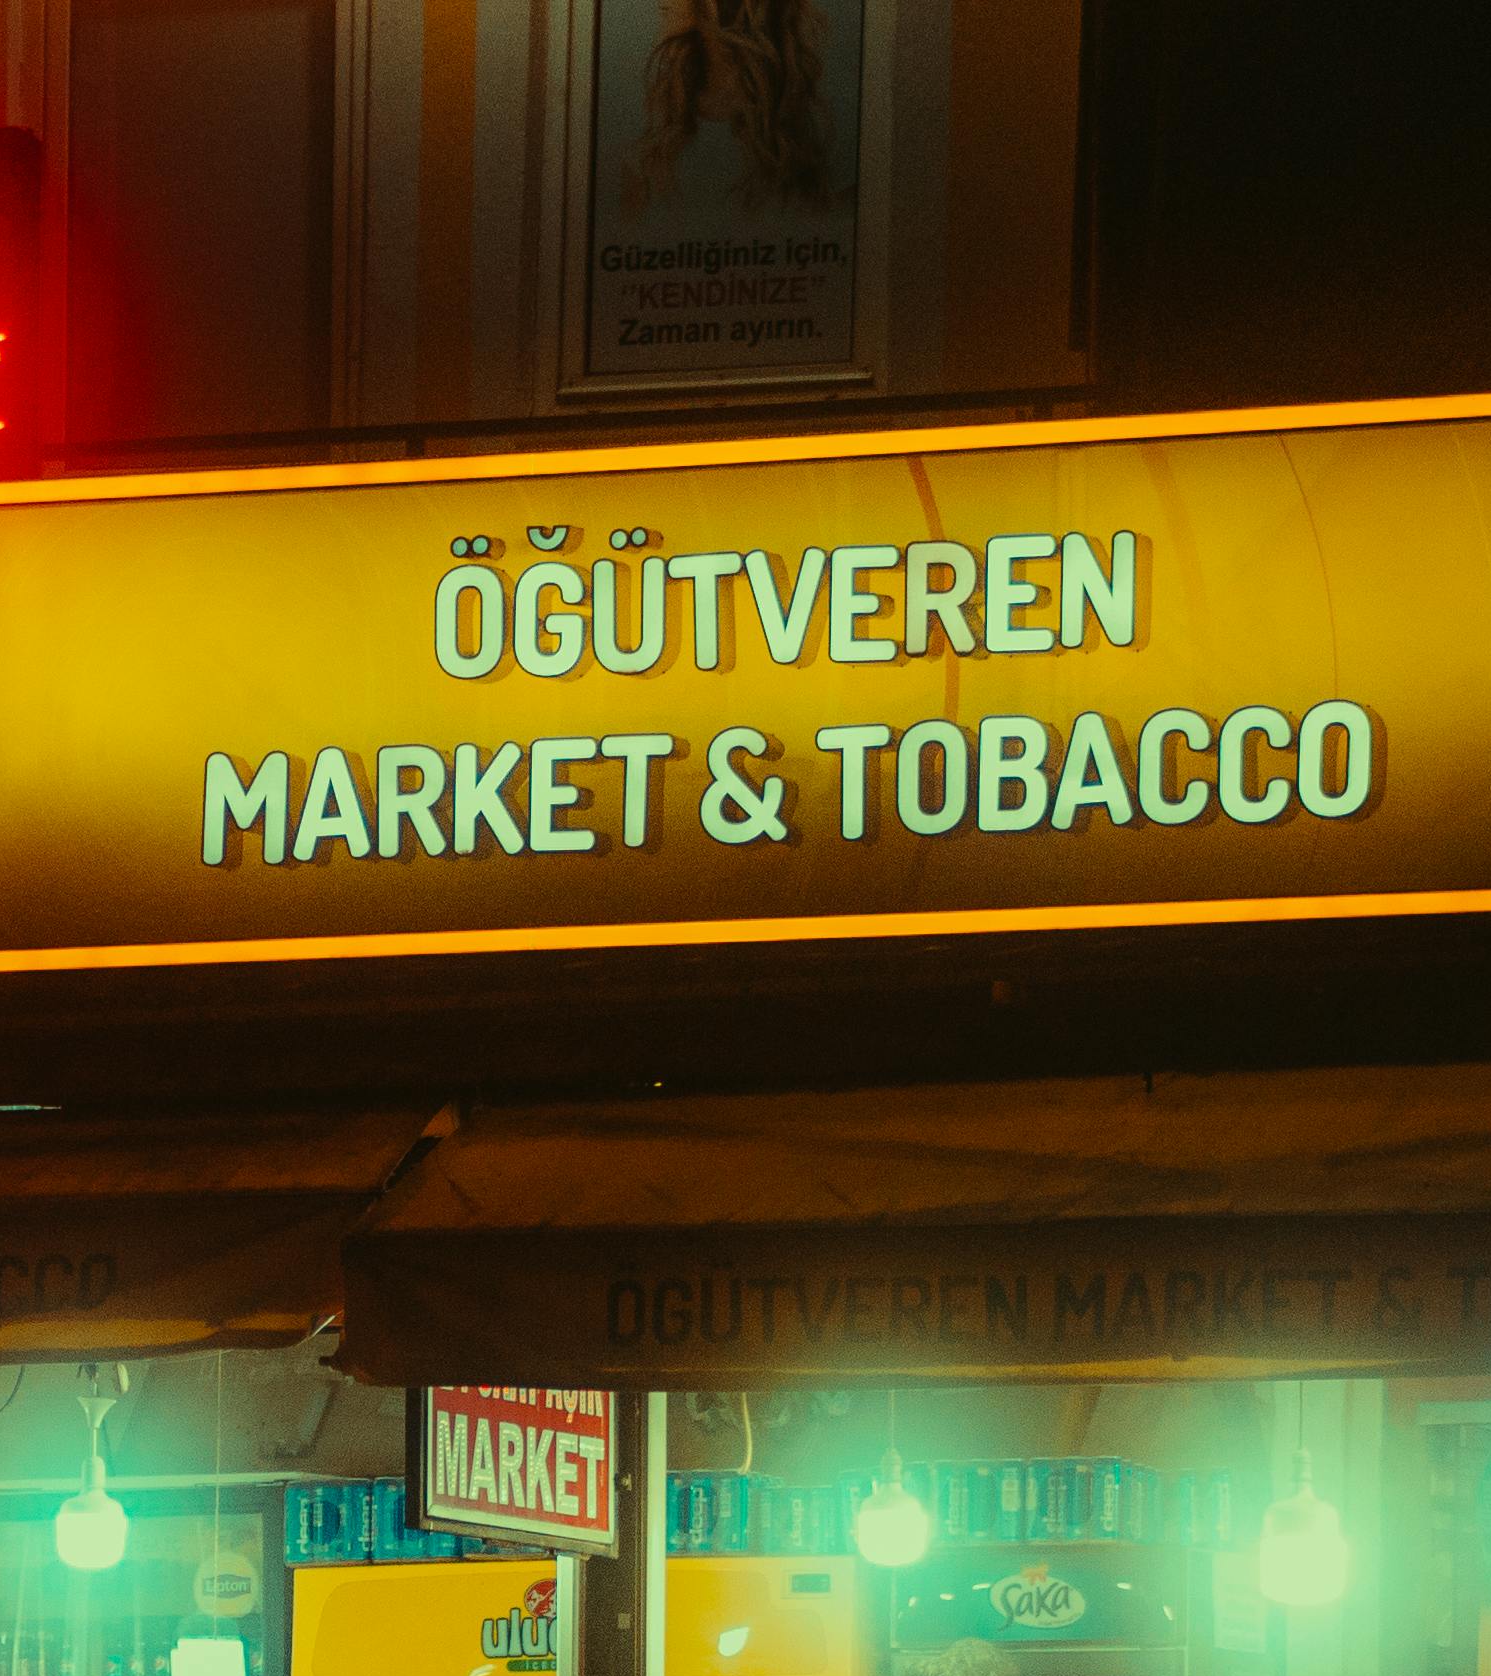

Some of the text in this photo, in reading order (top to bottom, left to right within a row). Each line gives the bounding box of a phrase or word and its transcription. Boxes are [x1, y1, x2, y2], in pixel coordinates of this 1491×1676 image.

[600, 236, 848, 275] Güzelliğiniz için,
[617, 316, 823, 347] Zaman ayırın.
[433, 523, 1139, 680] ÖĞÜTVEREN
[200, 698, 1374, 868] MARKET & TOBACCO
[1052, 1264, 1353, 1345] MARKET
[1372, 1264, 1424, 1341] &
[436, 1410, 605, 1520] MARKET
[997, 1583, 1072, 1631] Saka
